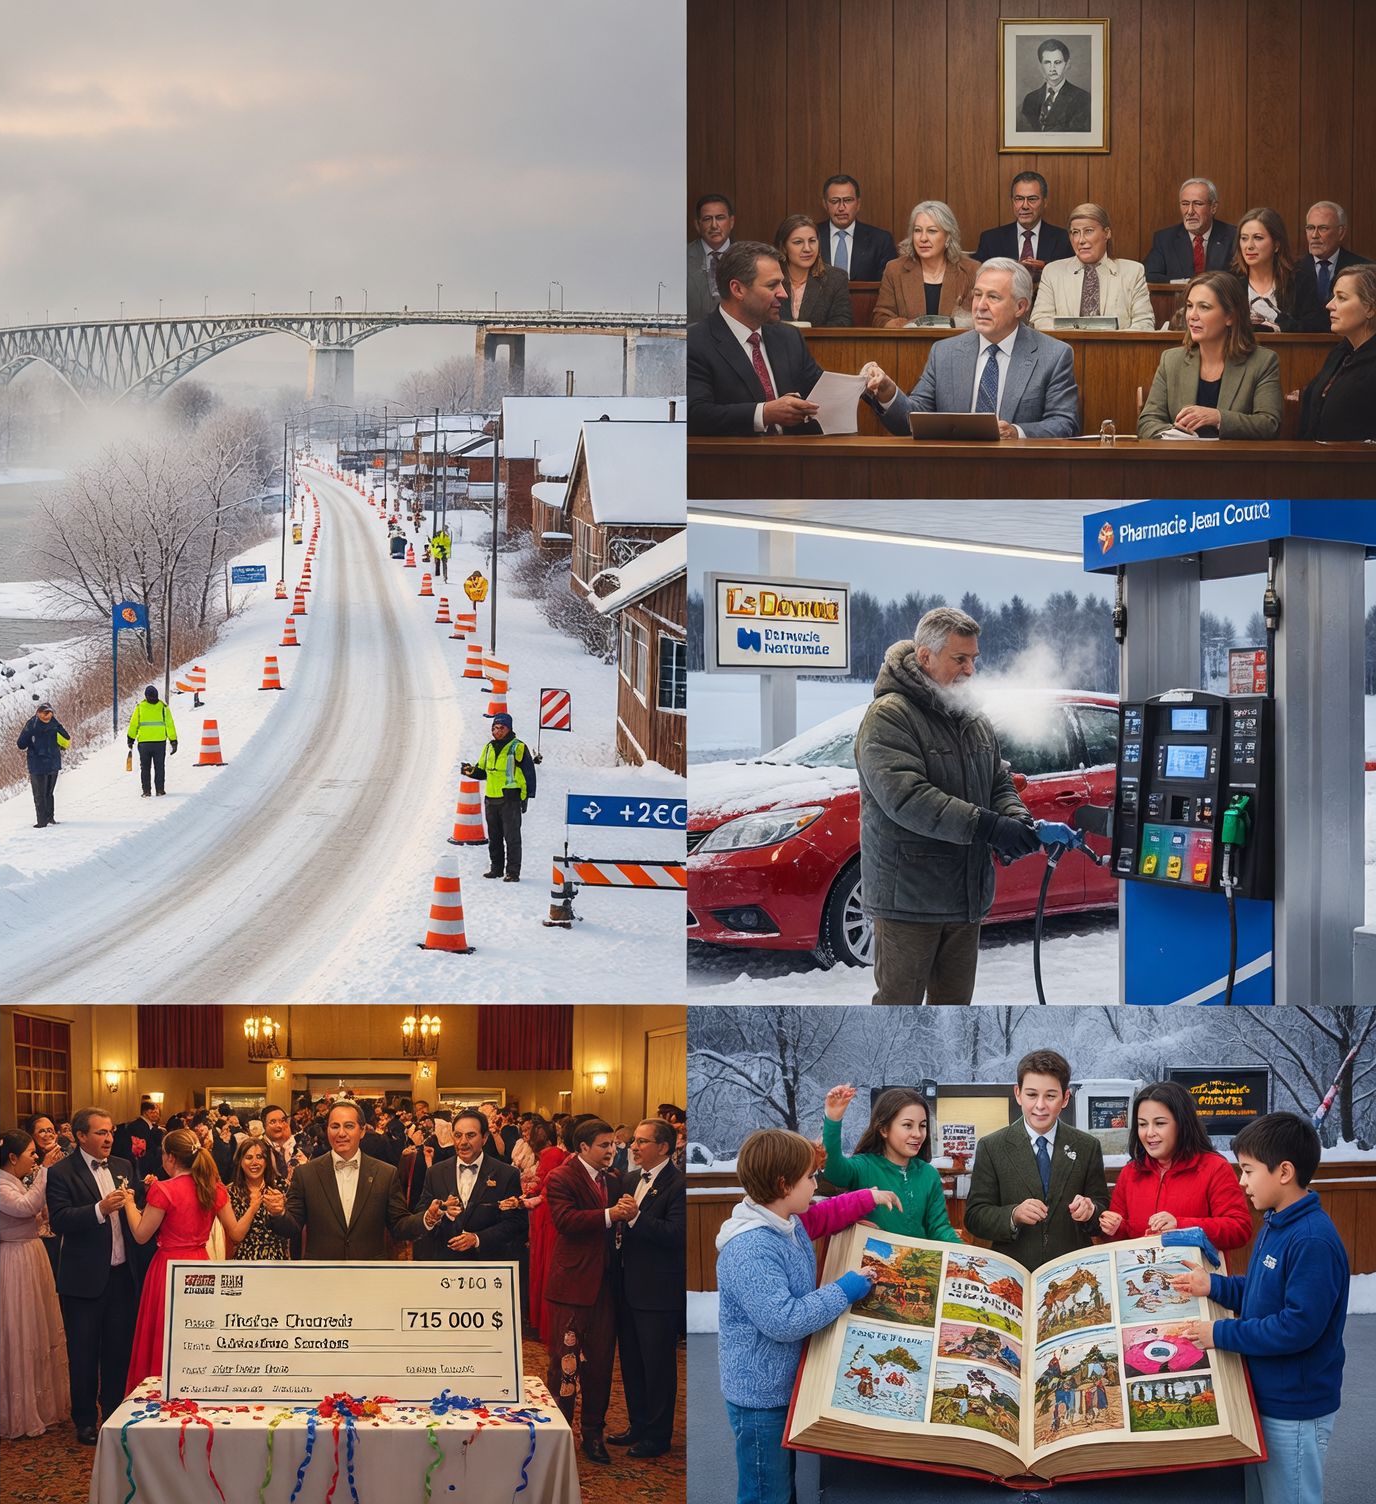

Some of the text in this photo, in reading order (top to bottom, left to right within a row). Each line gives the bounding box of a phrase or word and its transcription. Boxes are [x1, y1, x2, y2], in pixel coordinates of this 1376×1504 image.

[1119, 514, 1187, 544] Pharmacie
[407, 1310, 504, 1331] 715 000 $
